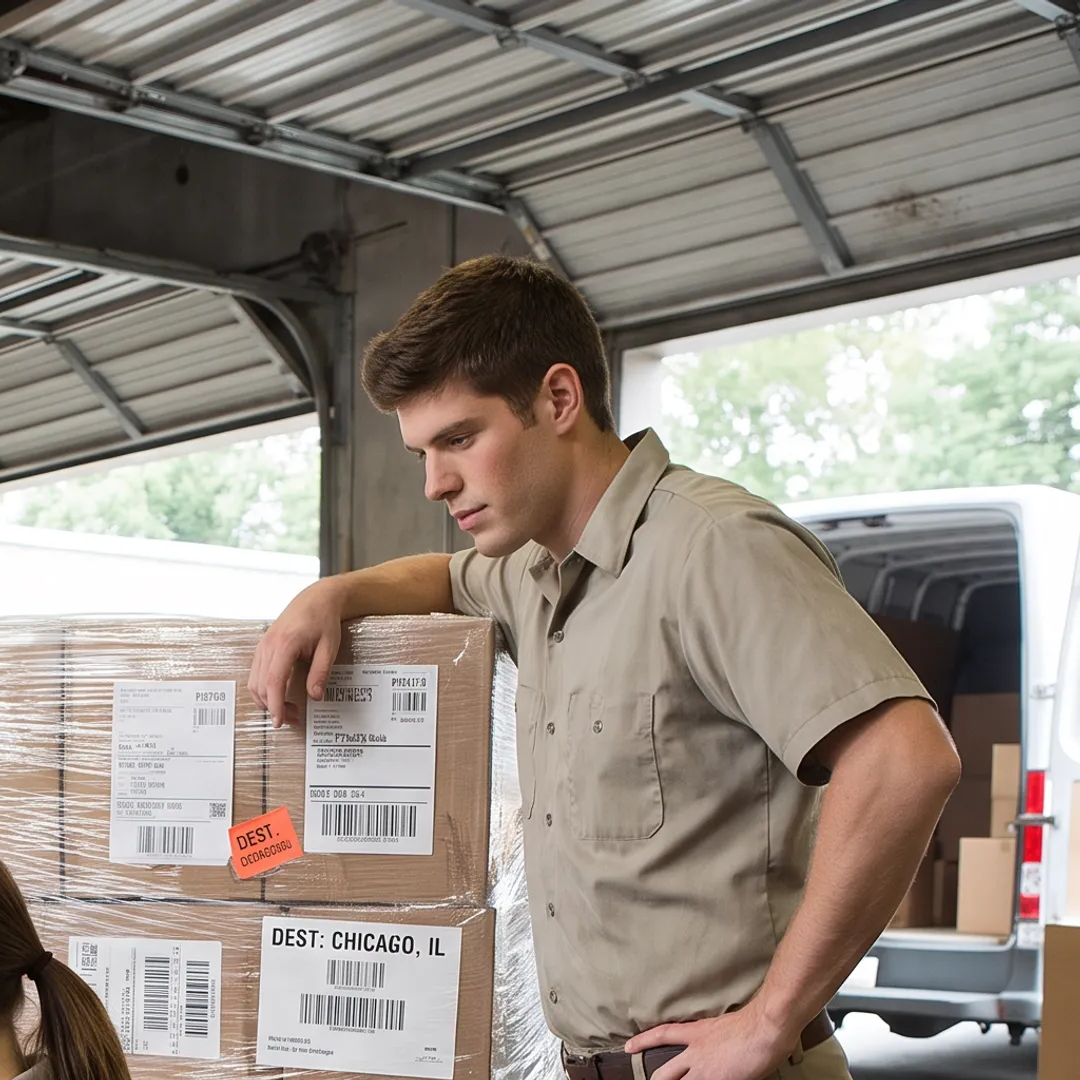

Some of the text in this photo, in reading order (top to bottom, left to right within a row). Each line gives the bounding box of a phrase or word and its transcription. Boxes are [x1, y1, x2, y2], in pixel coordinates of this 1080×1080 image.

[236, 823, 280, 851] DEST.
[271, 927, 446, 958] DEST: CHICAGO, IL
